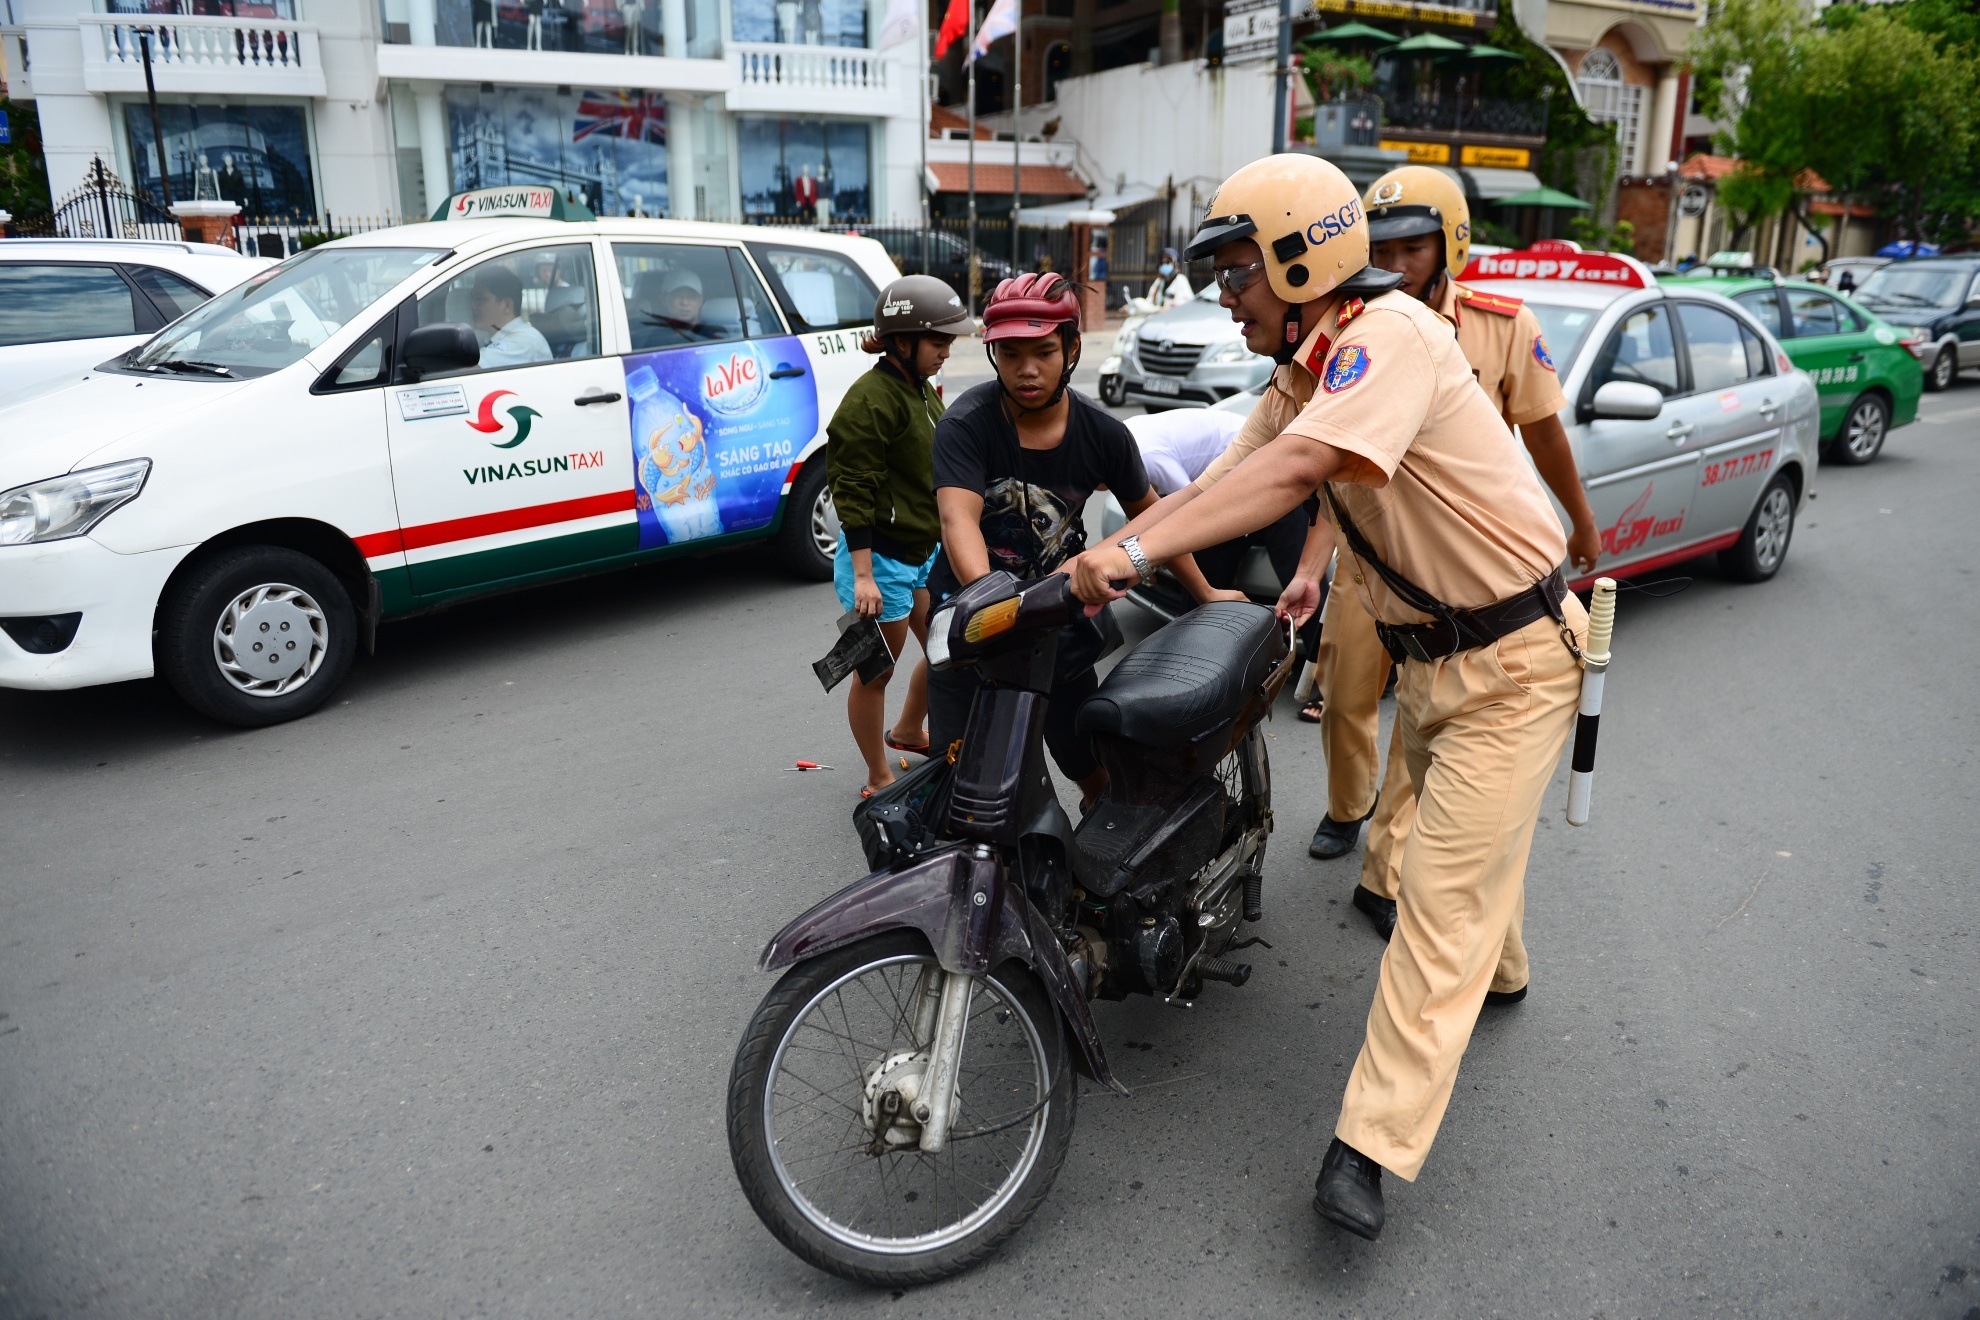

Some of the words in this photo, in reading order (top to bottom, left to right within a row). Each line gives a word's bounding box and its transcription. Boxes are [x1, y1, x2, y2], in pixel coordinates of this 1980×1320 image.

[478, 192, 529, 212] VINASUN
[529, 191, 553, 208] TAXI
[1306, 198, 1364, 246] CSGT
[1477, 256, 1579, 280] happy
[1573, 267, 1630, 281] taxi
[817, 333, 847, 355] 51A
[1702, 449, 1774, 487] 38.77.77.77
